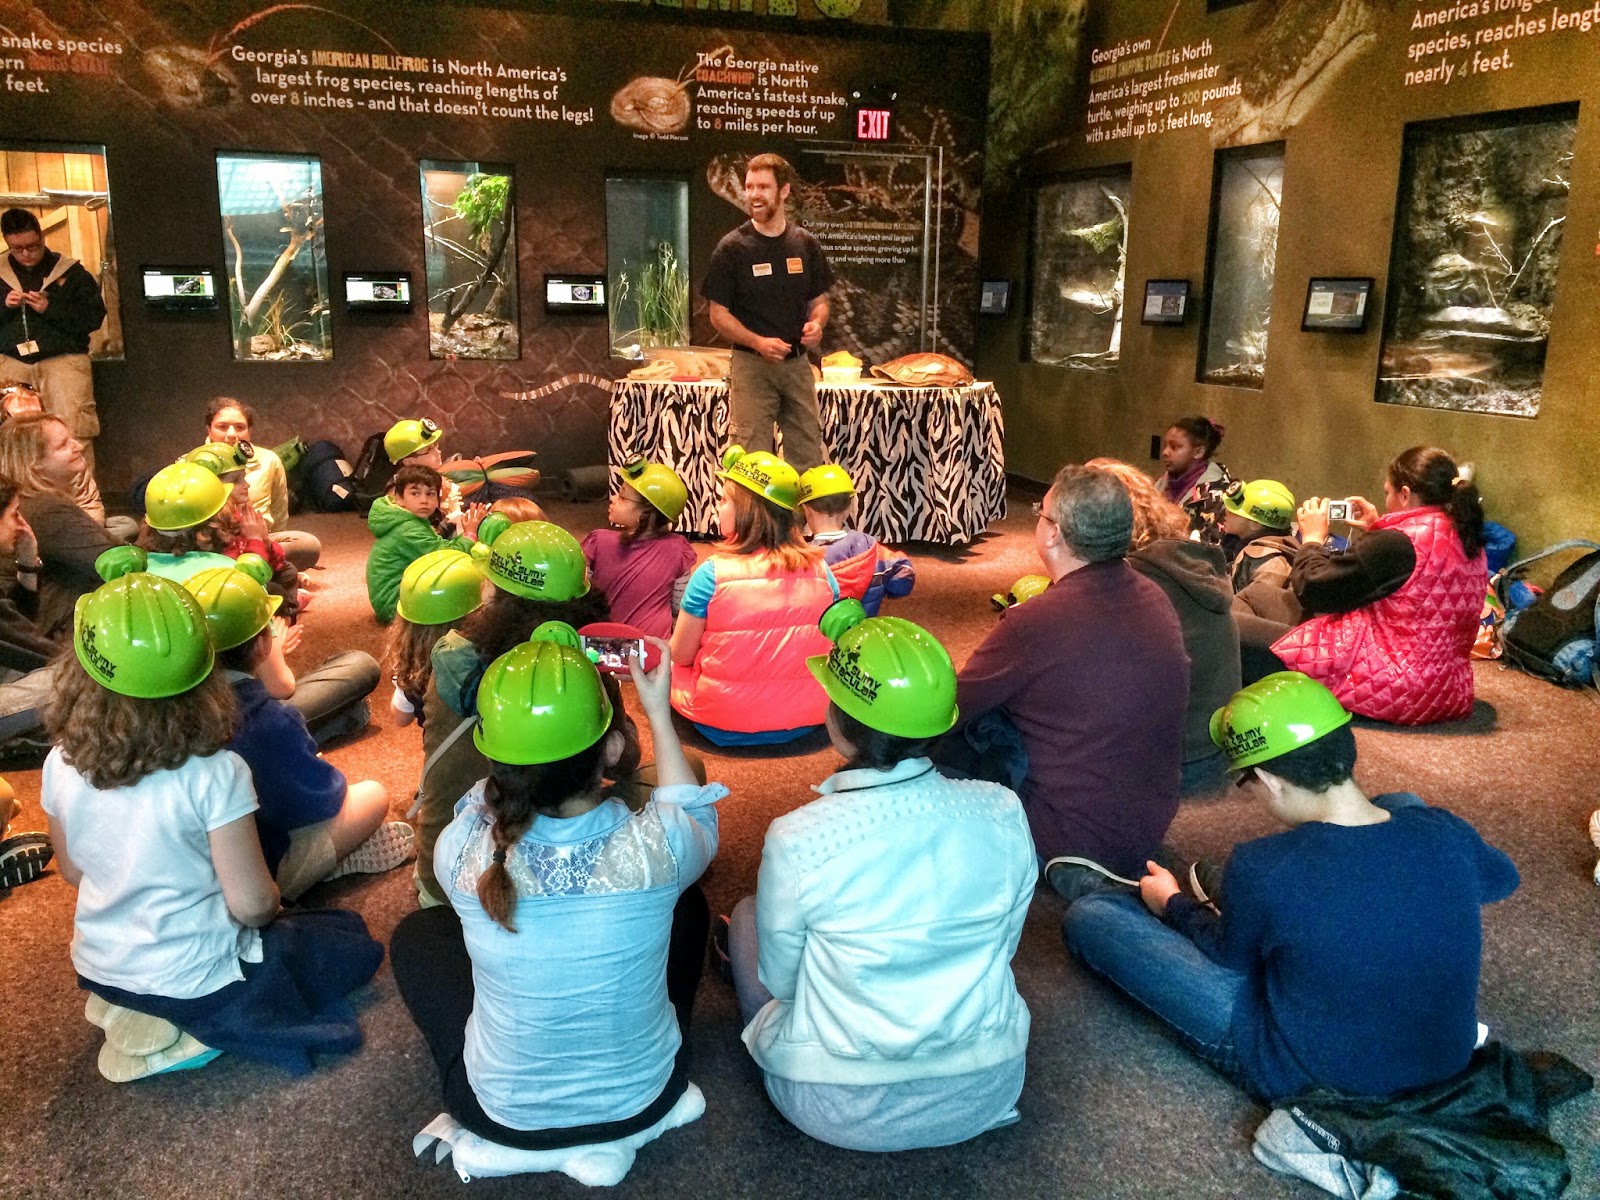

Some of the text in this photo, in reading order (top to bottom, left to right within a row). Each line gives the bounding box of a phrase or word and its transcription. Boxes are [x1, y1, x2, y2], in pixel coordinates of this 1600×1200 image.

[1410, 0, 1490, 31] America's
[1, 32, 122, 55] snake species
[1408, 31, 1471, 62] species,
[1475, 14, 1547, 45] reaches
[231, 45, 567, 82] Georgia's AMERICAN BULLFROG is North America's
[696, 52, 819, 74] The Georgia native
[1091, 39, 1151, 64] Georgia's own
[1171, 50, 1180, 65] is
[1181, 38, 1213, 62] North
[696, 69, 809, 88] COACHWHIP is North
[1404, 48, 1514, 86] nearly 4 feet.
[6, 74, 49, 93] feet.
[256, 67, 559, 102] largest frog species, reaching lengths of
[697, 85, 849, 107] America's fastest snake,
[1088, 63, 1220, 105] America's largest freshwater
[250, 92, 287, 105] over
[290, 91, 300, 105] 8
[303, 91, 354, 109] inches
[367, 95, 396, 111] and
[399, 96, 431, 113] that
[433, 98, 488, 117] doesn't
[491, 104, 533, 119] count
[535, 104, 559, 120] the
[562, 105, 594, 126] legs!
[696, 101, 836, 123] reaching speeds of up
[1087, 77, 1242, 124] turtle, weighing up to 200 pounds
[697, 117, 818, 135] to 8 miles per hour.
[858, 110, 890, 139] EXIT
[1086, 109, 1214, 143] with a shell up to 3 feet long.
[802, 220, 815, 229] Our
[816, 222, 831, 230] very
[858, 233, 880, 242] longest
[893, 234, 914, 243] largest
[877, 246, 902, 254] growing
[847, 255, 874, 265] weighing
[892, 256, 906, 264] than
